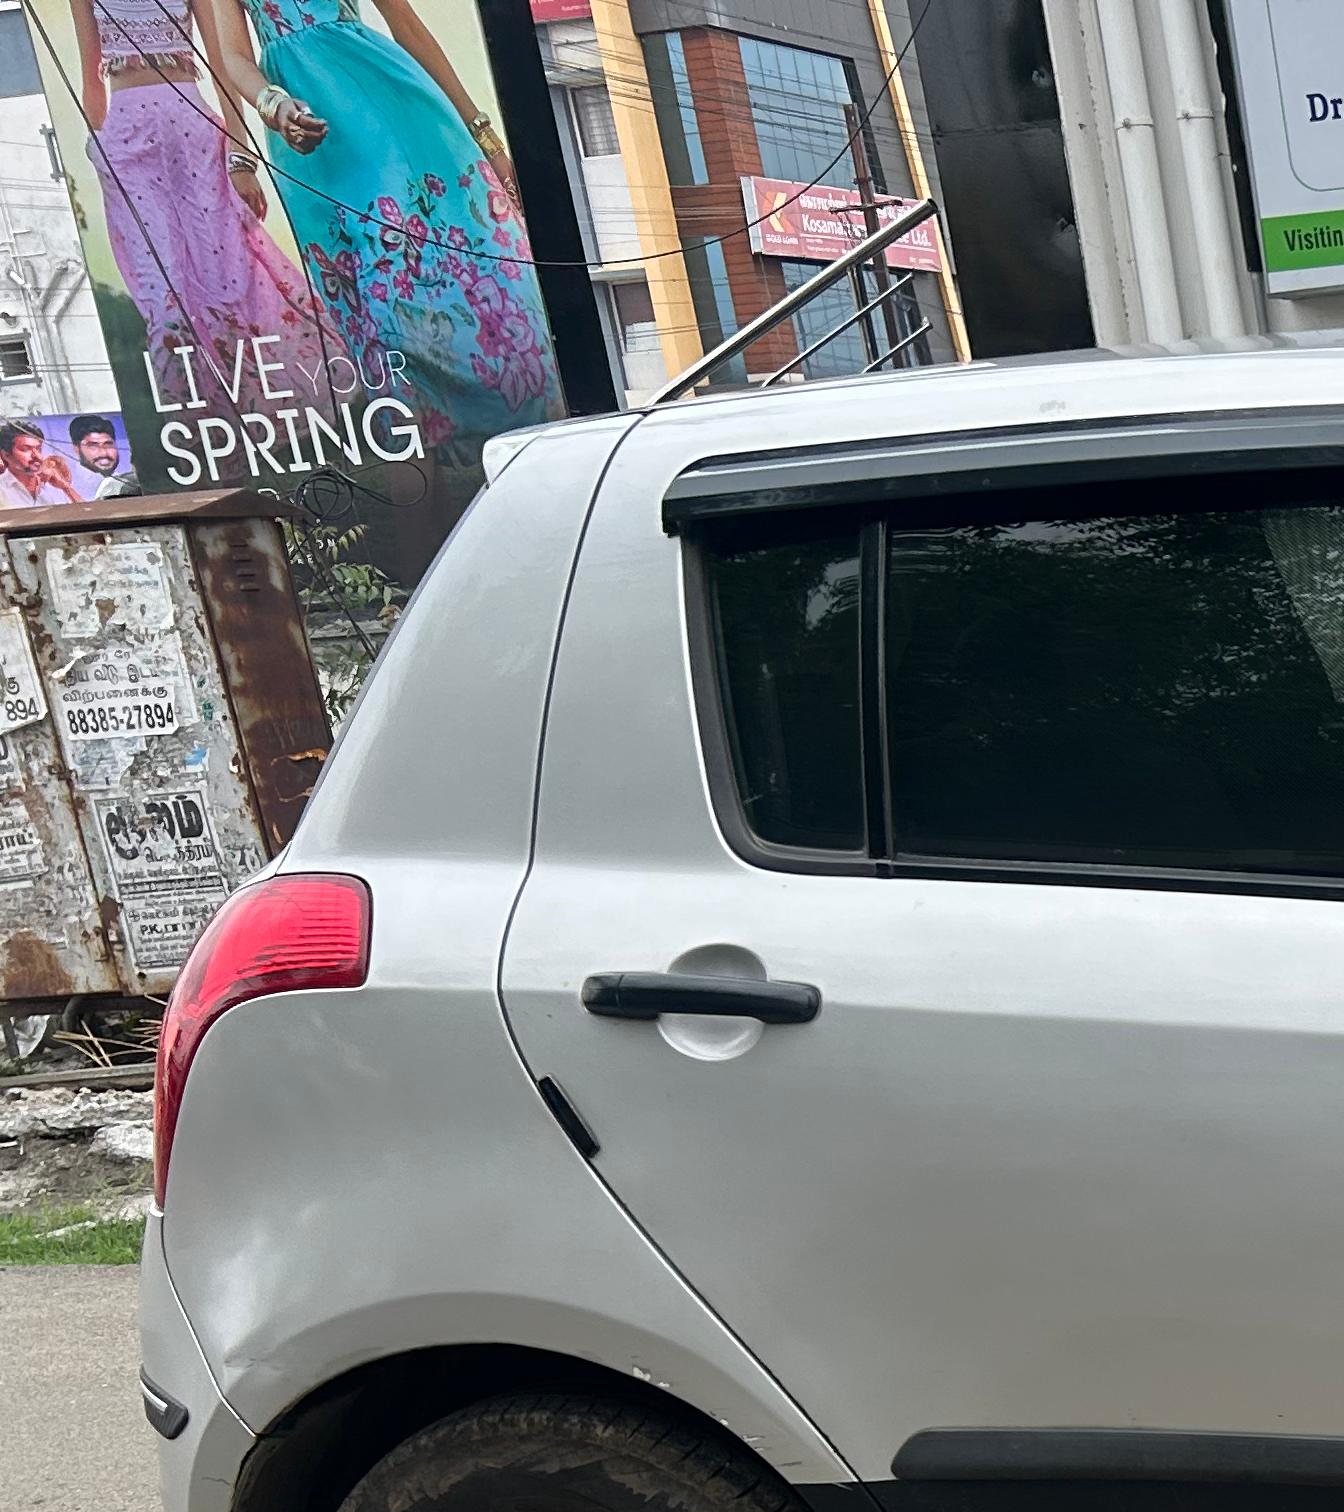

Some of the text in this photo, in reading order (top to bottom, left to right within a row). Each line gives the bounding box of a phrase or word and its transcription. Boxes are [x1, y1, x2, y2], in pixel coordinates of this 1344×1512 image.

[143, 335, 411, 413] LIVE YOUR
[160, 397, 425, 485] SPRING
[5, 698, 39, 721] 894
[66, 702, 174, 735] 88385-27894
